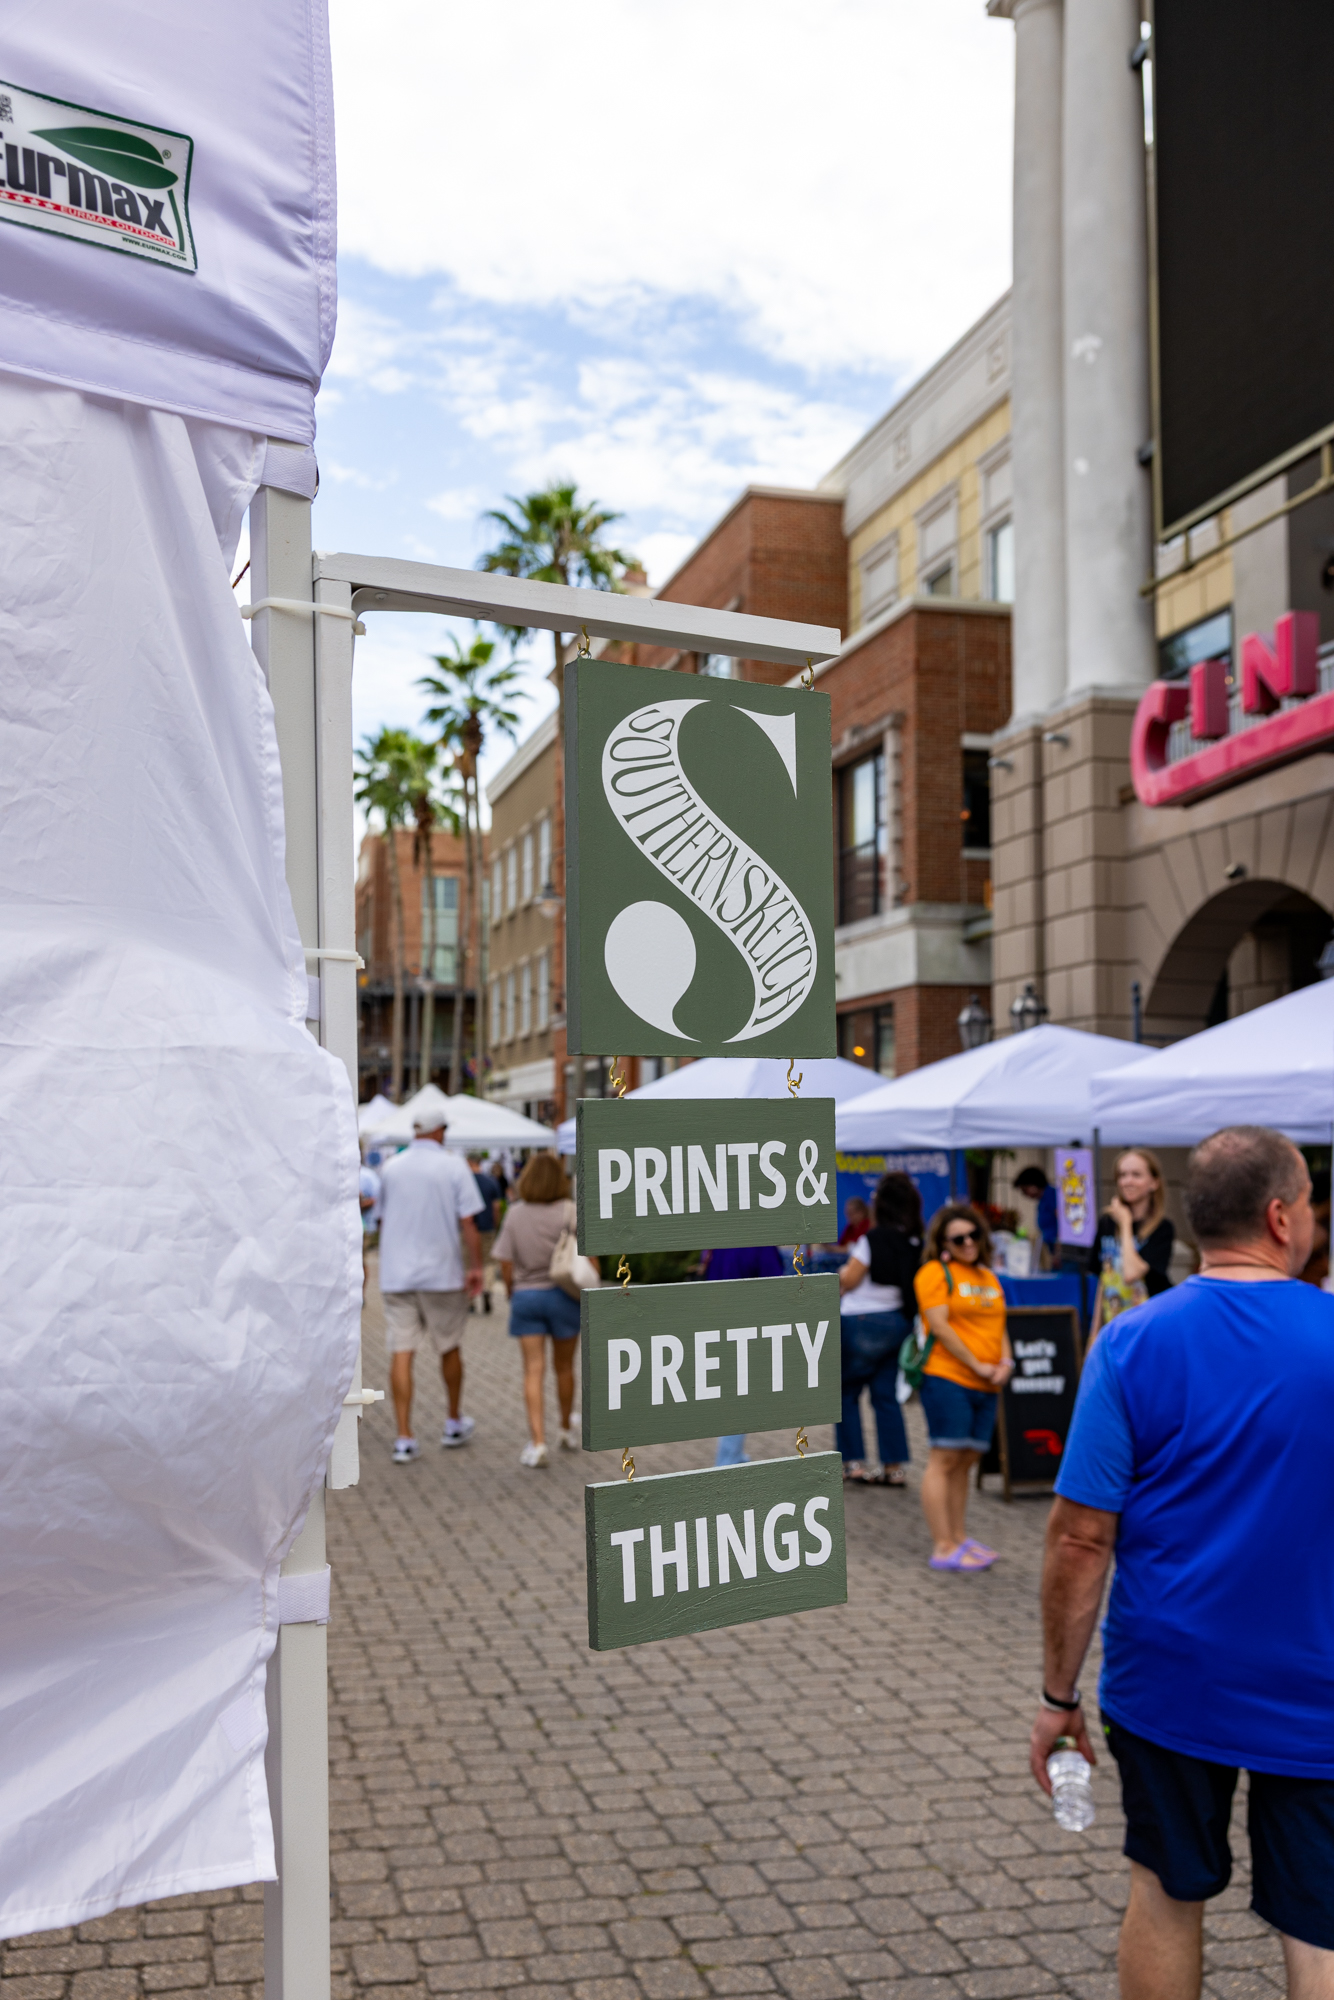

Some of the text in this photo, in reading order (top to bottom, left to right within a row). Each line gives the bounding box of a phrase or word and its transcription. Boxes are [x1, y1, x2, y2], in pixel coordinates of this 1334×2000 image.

[60, 206, 176, 248] EURMAX OUTDOOR
[598, 1139, 830, 1219] PRINTS &
[607, 1320, 829, 1410] PRETTY
[610, 1496, 833, 1604] THINGS
